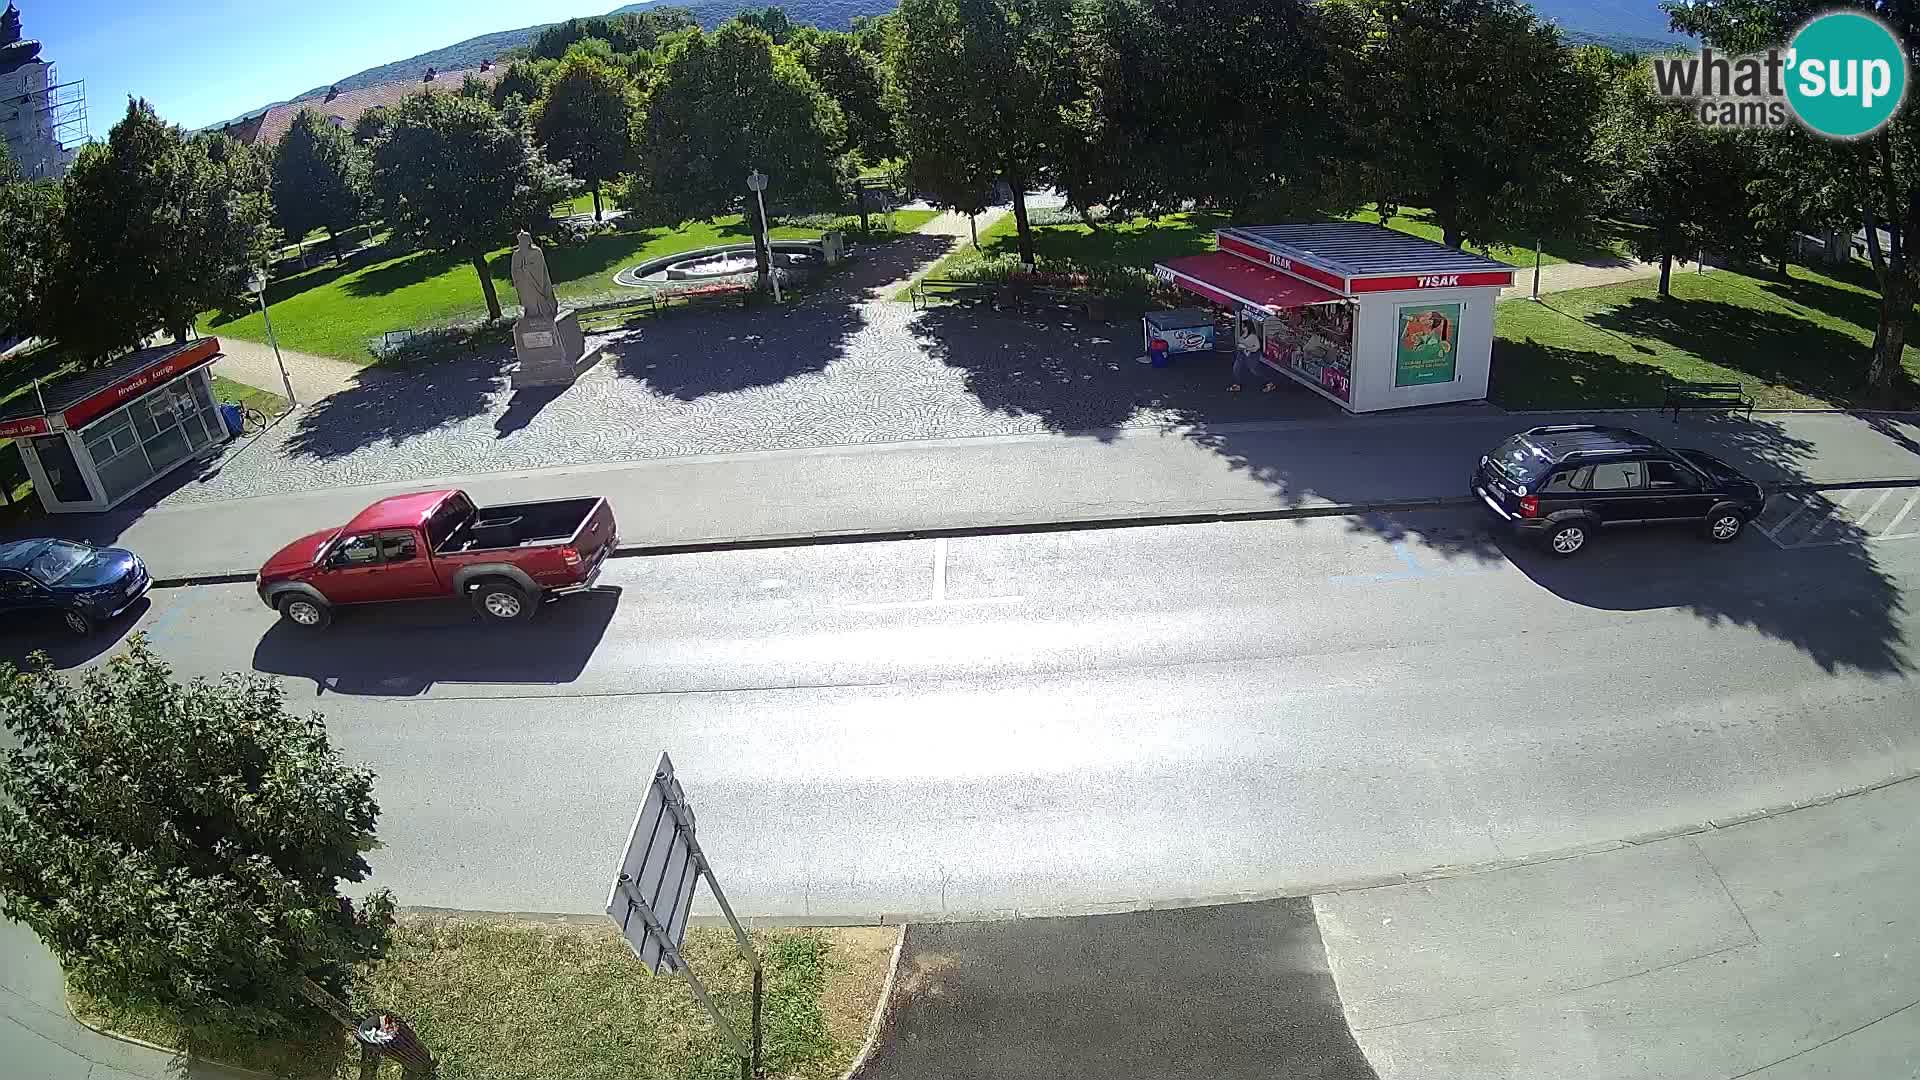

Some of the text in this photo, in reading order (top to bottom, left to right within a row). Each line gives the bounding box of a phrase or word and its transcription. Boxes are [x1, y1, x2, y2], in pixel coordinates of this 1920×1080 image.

[1268, 253, 1293, 271] TISAK
[1154, 267, 1176, 282] TISAK
[1417, 275, 1460, 288] TISAK
